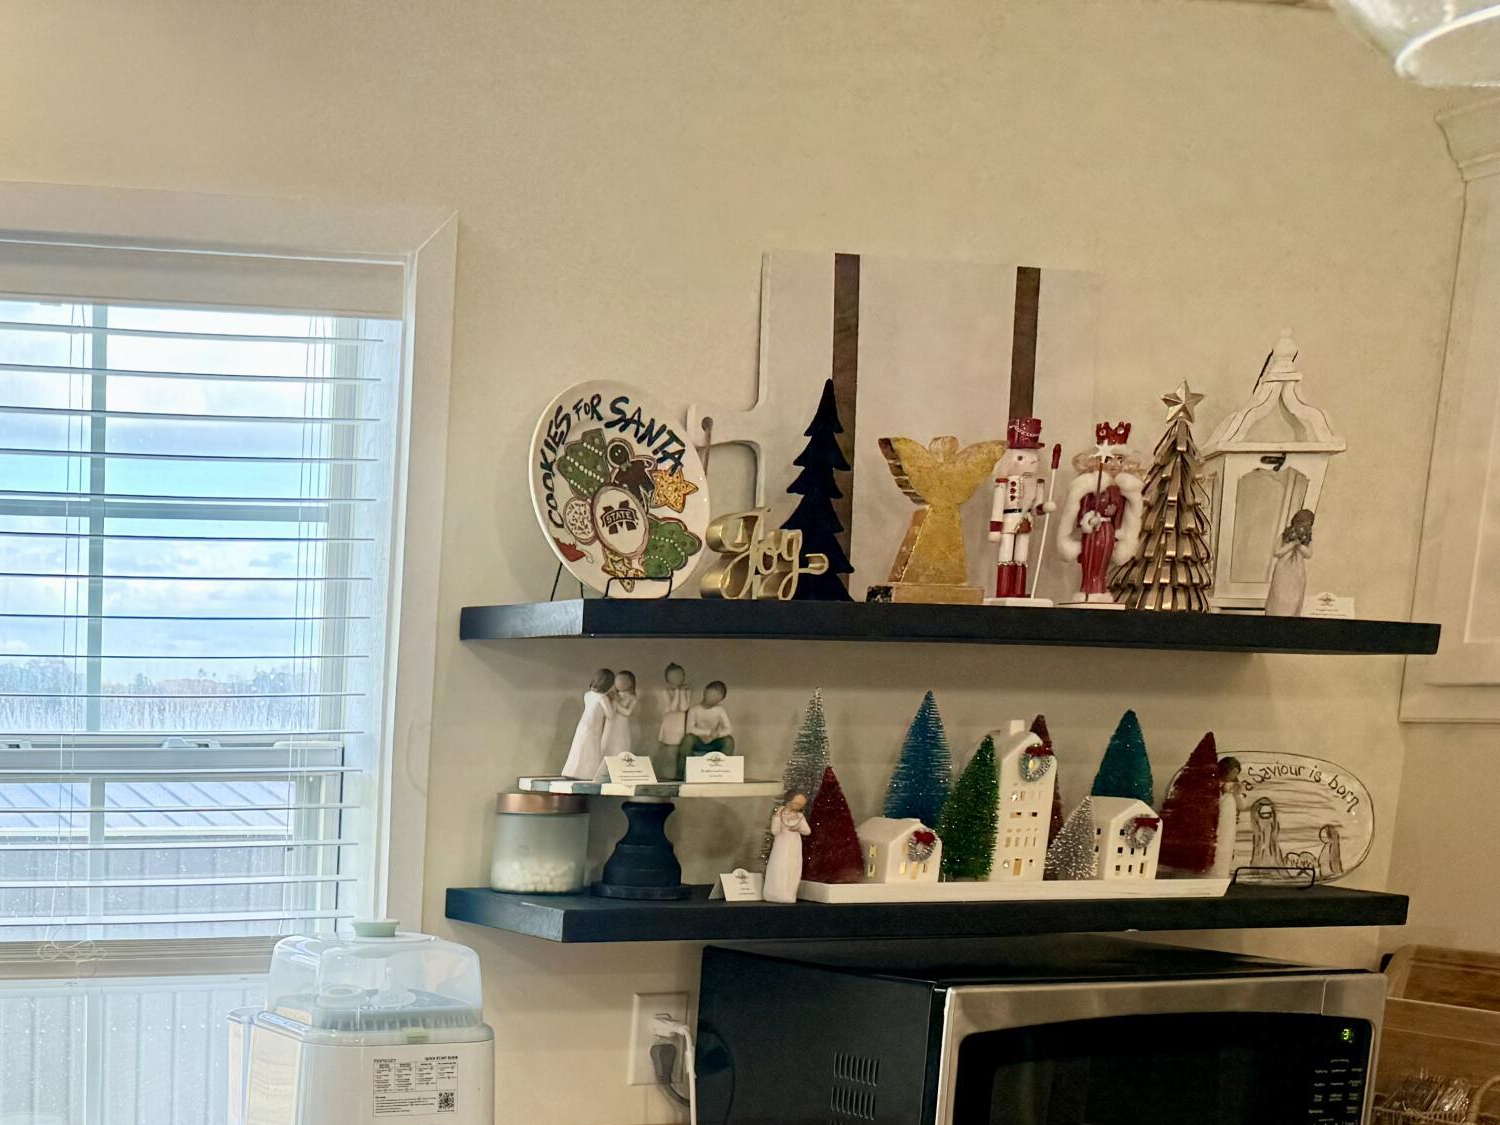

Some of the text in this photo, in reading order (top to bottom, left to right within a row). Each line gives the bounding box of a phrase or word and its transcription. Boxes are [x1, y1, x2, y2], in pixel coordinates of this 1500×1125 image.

[540, 393, 687, 529] COOKIES FOR SANTA
[606, 510, 634, 524] STATE
[1247, 761, 1306, 784] Saviour
[1309, 764, 1322, 783] is
[1327, 774, 1360, 813] born
